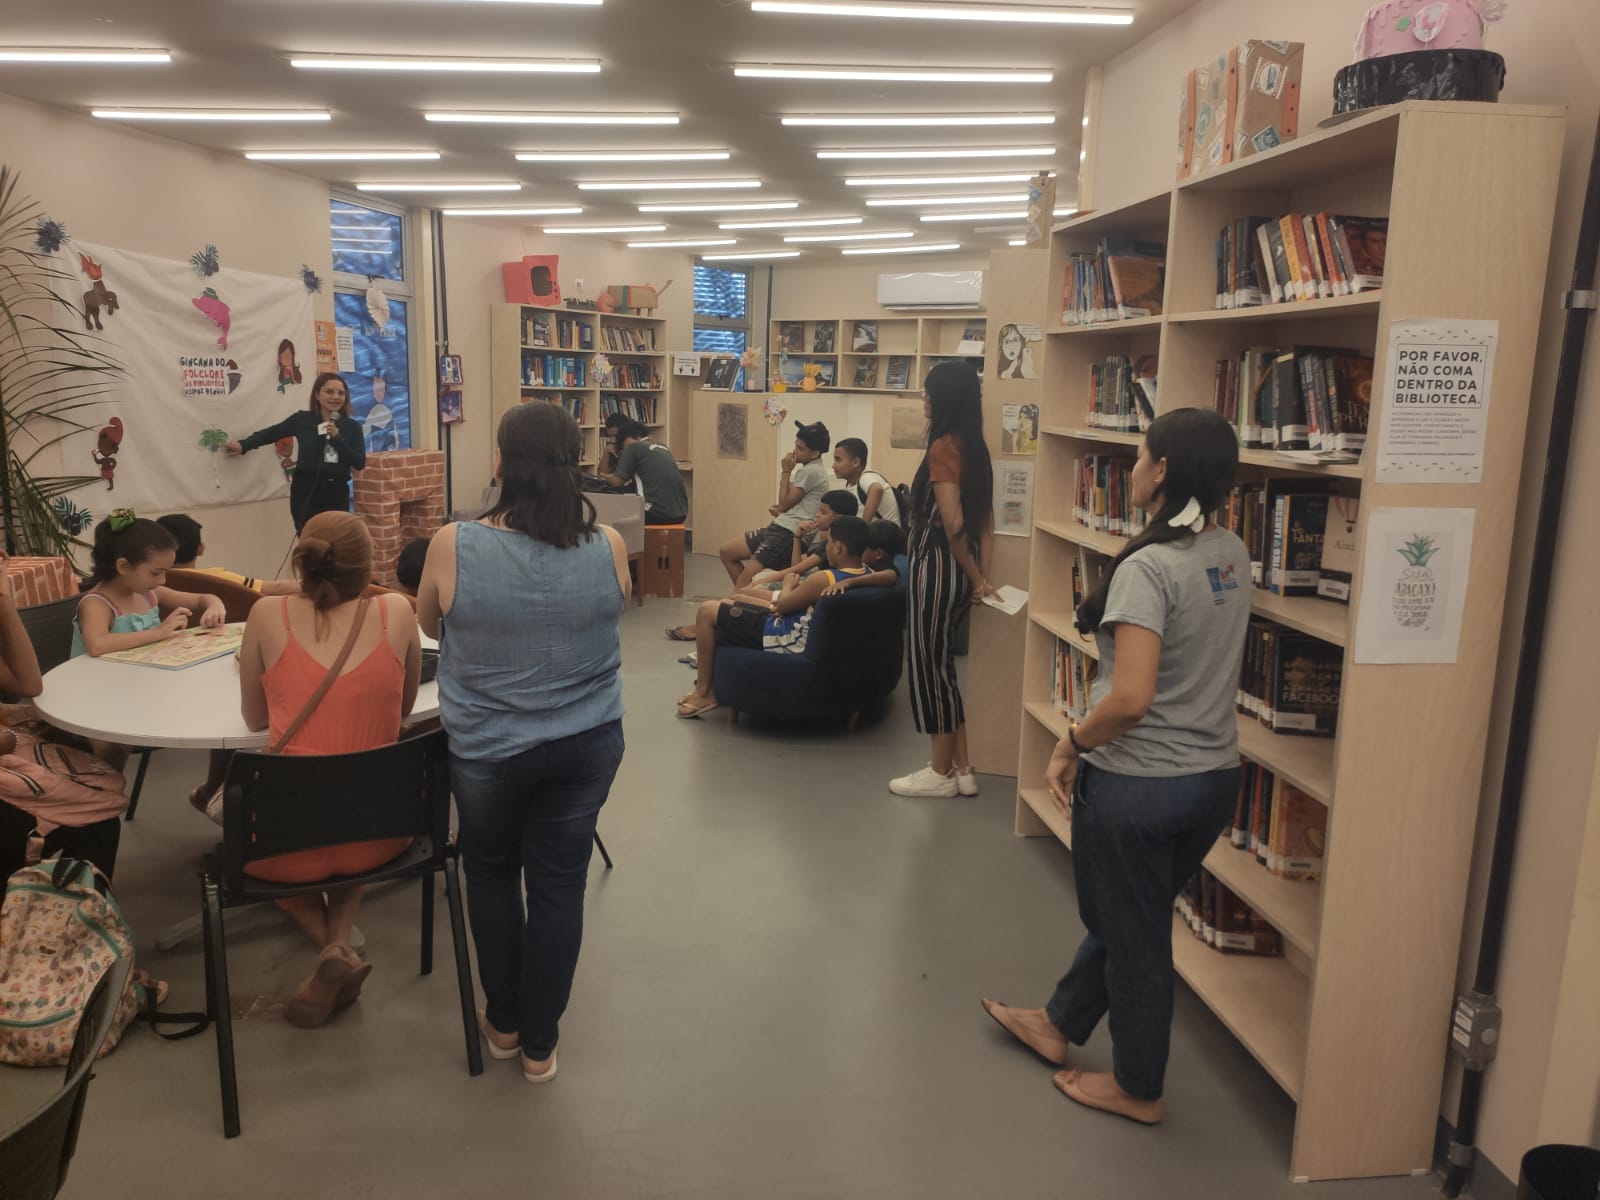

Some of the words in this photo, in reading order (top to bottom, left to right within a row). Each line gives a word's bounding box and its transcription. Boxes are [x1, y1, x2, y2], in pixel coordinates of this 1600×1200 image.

[179, 356, 213, 367] GINCANA
[215, 358, 225, 367] DO
[1399, 350, 1428, 362] POR
[184, 368, 225, 379] FOLCLORE
[1398, 362, 1429, 376] NÃO
[1433, 365, 1473, 376] COMA
[1397, 379, 1454, 390] DENTRO
[1458, 380, 1477, 390] DA
[1395, 393, 1480, 405] BIBLIOTECA.
[1283, 691, 1339, 704] FACEBOO
